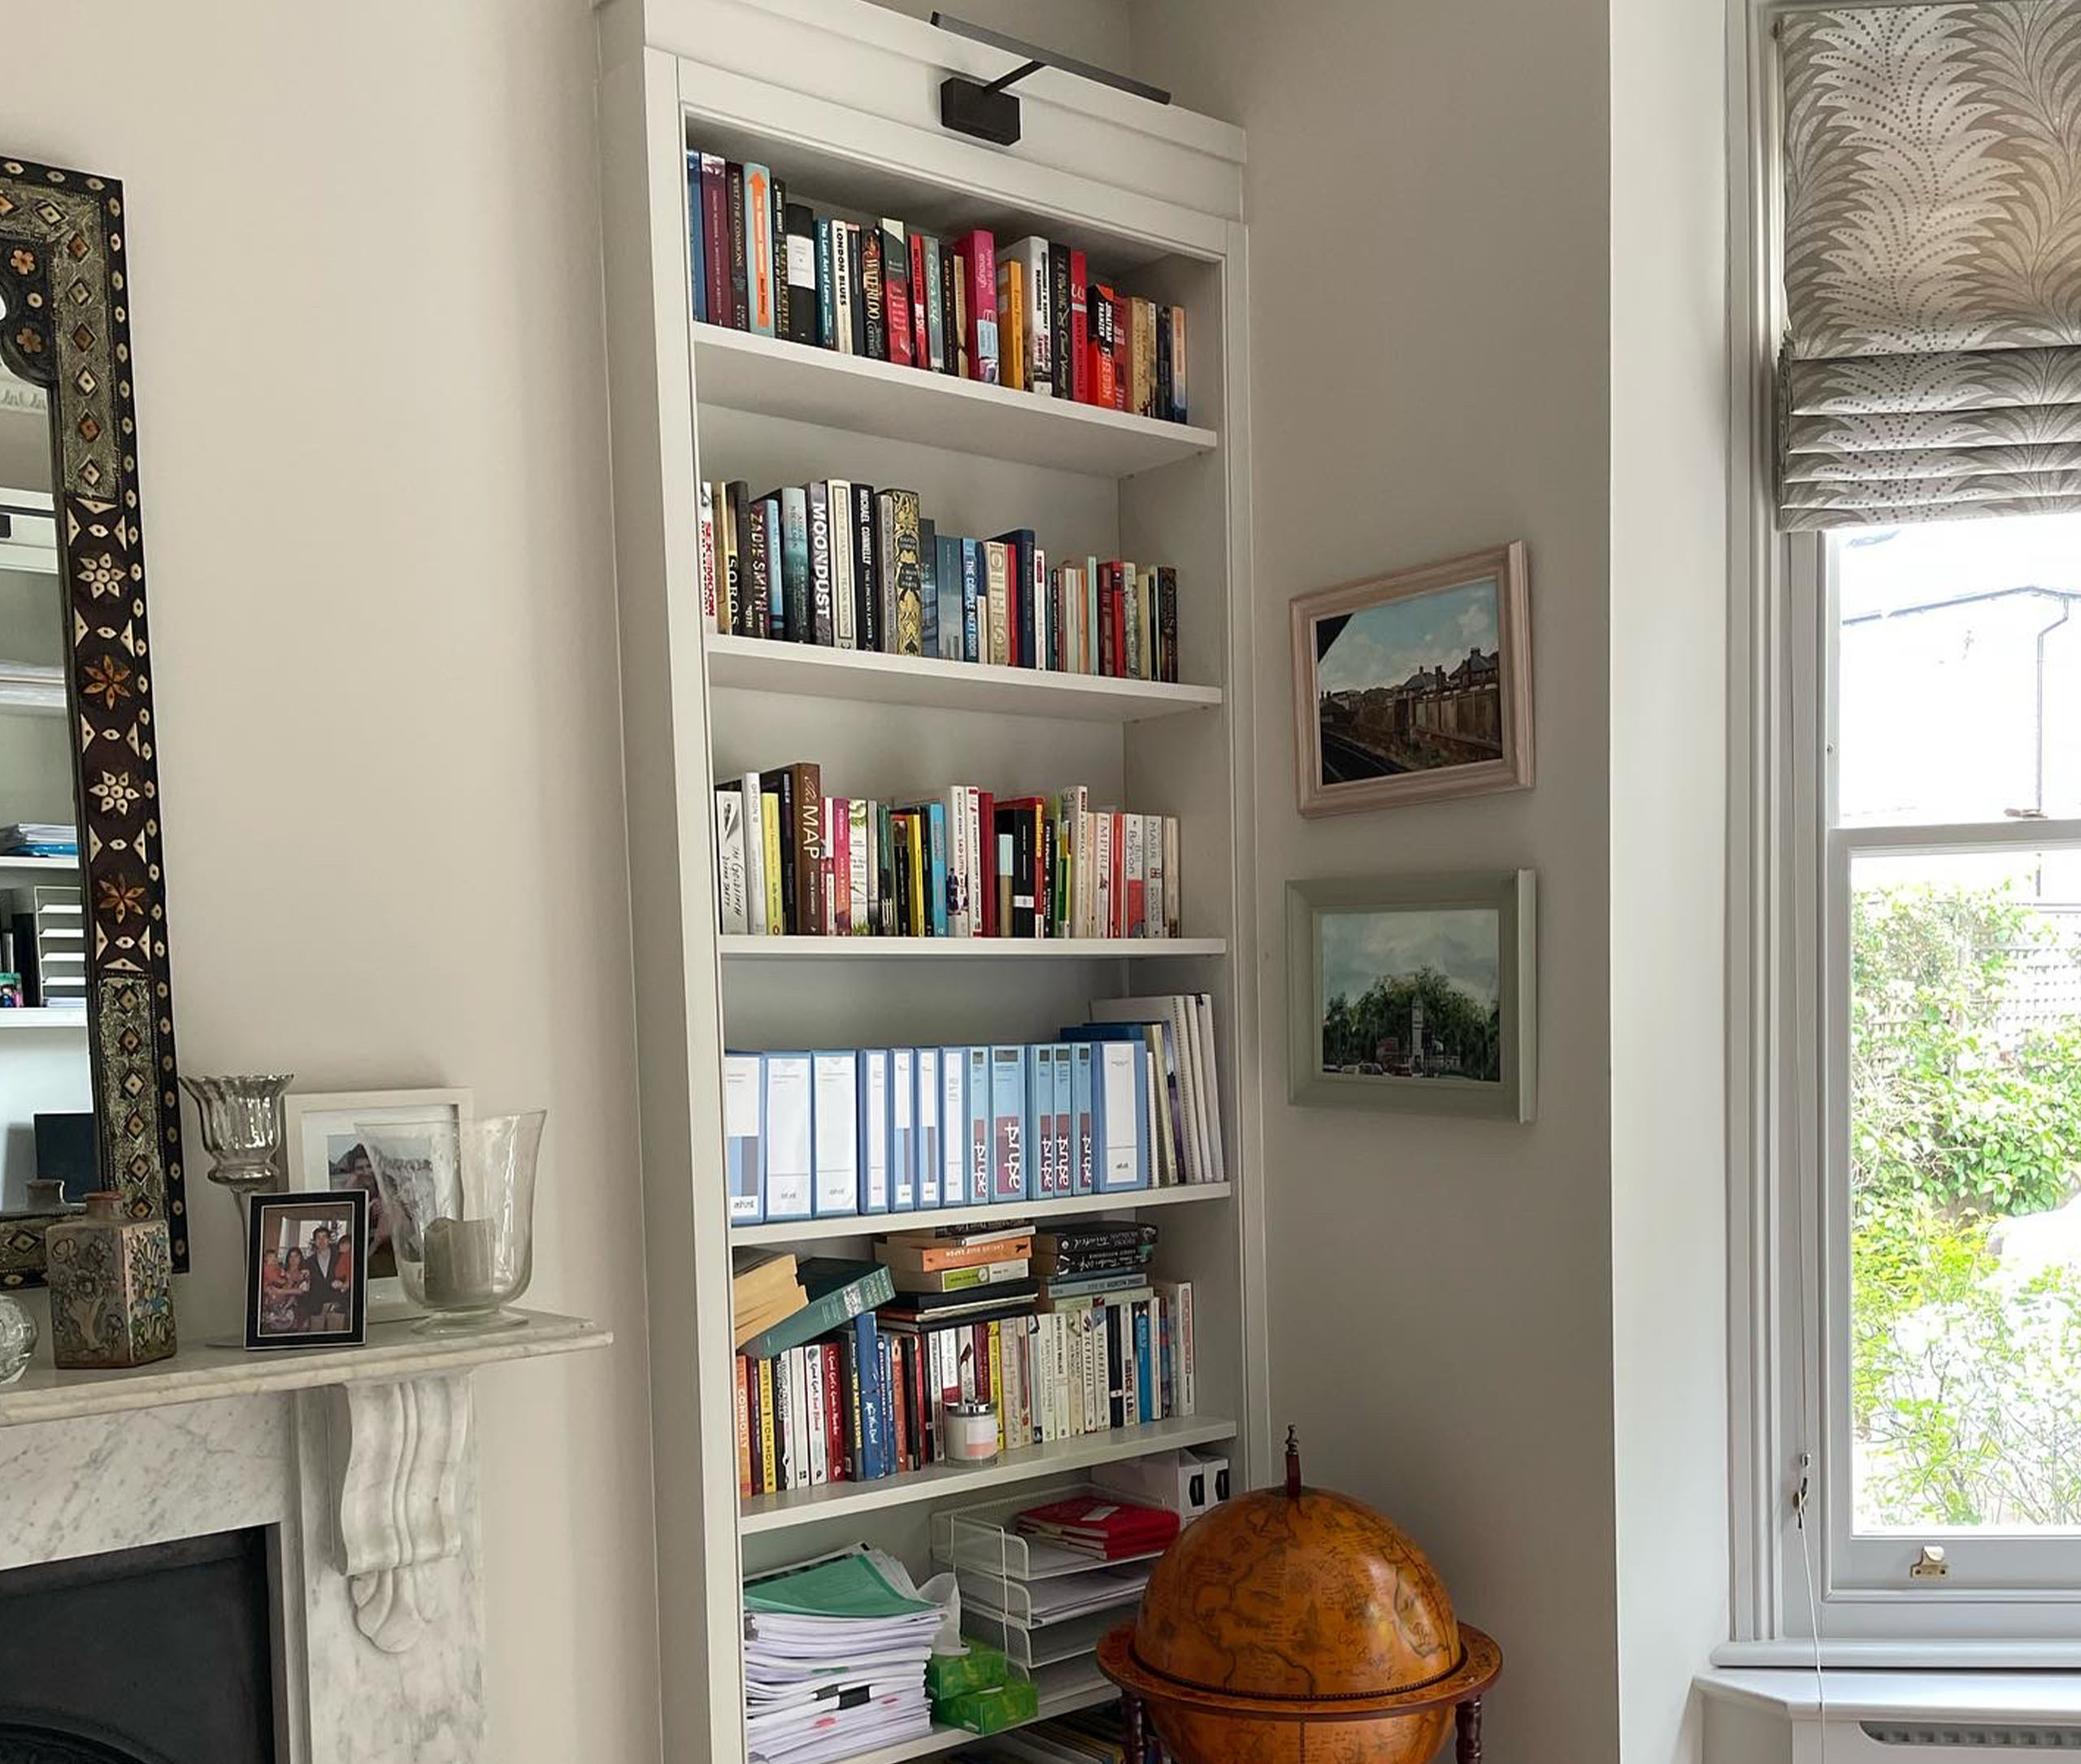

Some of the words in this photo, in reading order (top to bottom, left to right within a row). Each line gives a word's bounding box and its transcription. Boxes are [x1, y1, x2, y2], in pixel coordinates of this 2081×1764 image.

[836, 228, 845, 272] LONDON
[976, 253, 988, 289] enough
[823, 285, 832, 304] Love
[838, 275, 847, 306] BLUES
[865, 259, 880, 320] WATERLOO
[1101, 346, 1111, 399] FREEDOM
[789, 505, 798, 549] NICOLSON
[859, 489, 870, 523] MICHAEL
[751, 513, 765, 557] ZADIE
[862, 526, 871, 565] CONNELLY
[812, 502, 830, 619] MOONDUST
[728, 558, 739, 625] SOROS
[754, 561, 767, 611] SMITH
[967, 577, 975, 610] COUPLE
[967, 611, 975, 632] NEXT
[802, 805, 819, 859] MAP
[1036, 804, 1044, 858] Resilience
[1099, 816, 1109, 870] EMPIRE
[1127, 830, 1138, 874] Bryson
[1149, 821, 1158, 859] MARR
[974, 1141, 987, 1193] ashurst
[1004, 1122, 1020, 1189] ashurst
[1041, 1137, 1054, 1188] ashurst
[1056, 1135, 1068, 1186] ashurst
[762, 1362, 770, 1408] HIRTEEN
[1125, 1359, 1134, 1393] BRICK
[738, 1388, 747, 1448] CONNOLLY
[854, 1408, 862, 1449] AWESOME
[765, 1445, 773, 1478] HOYLE
